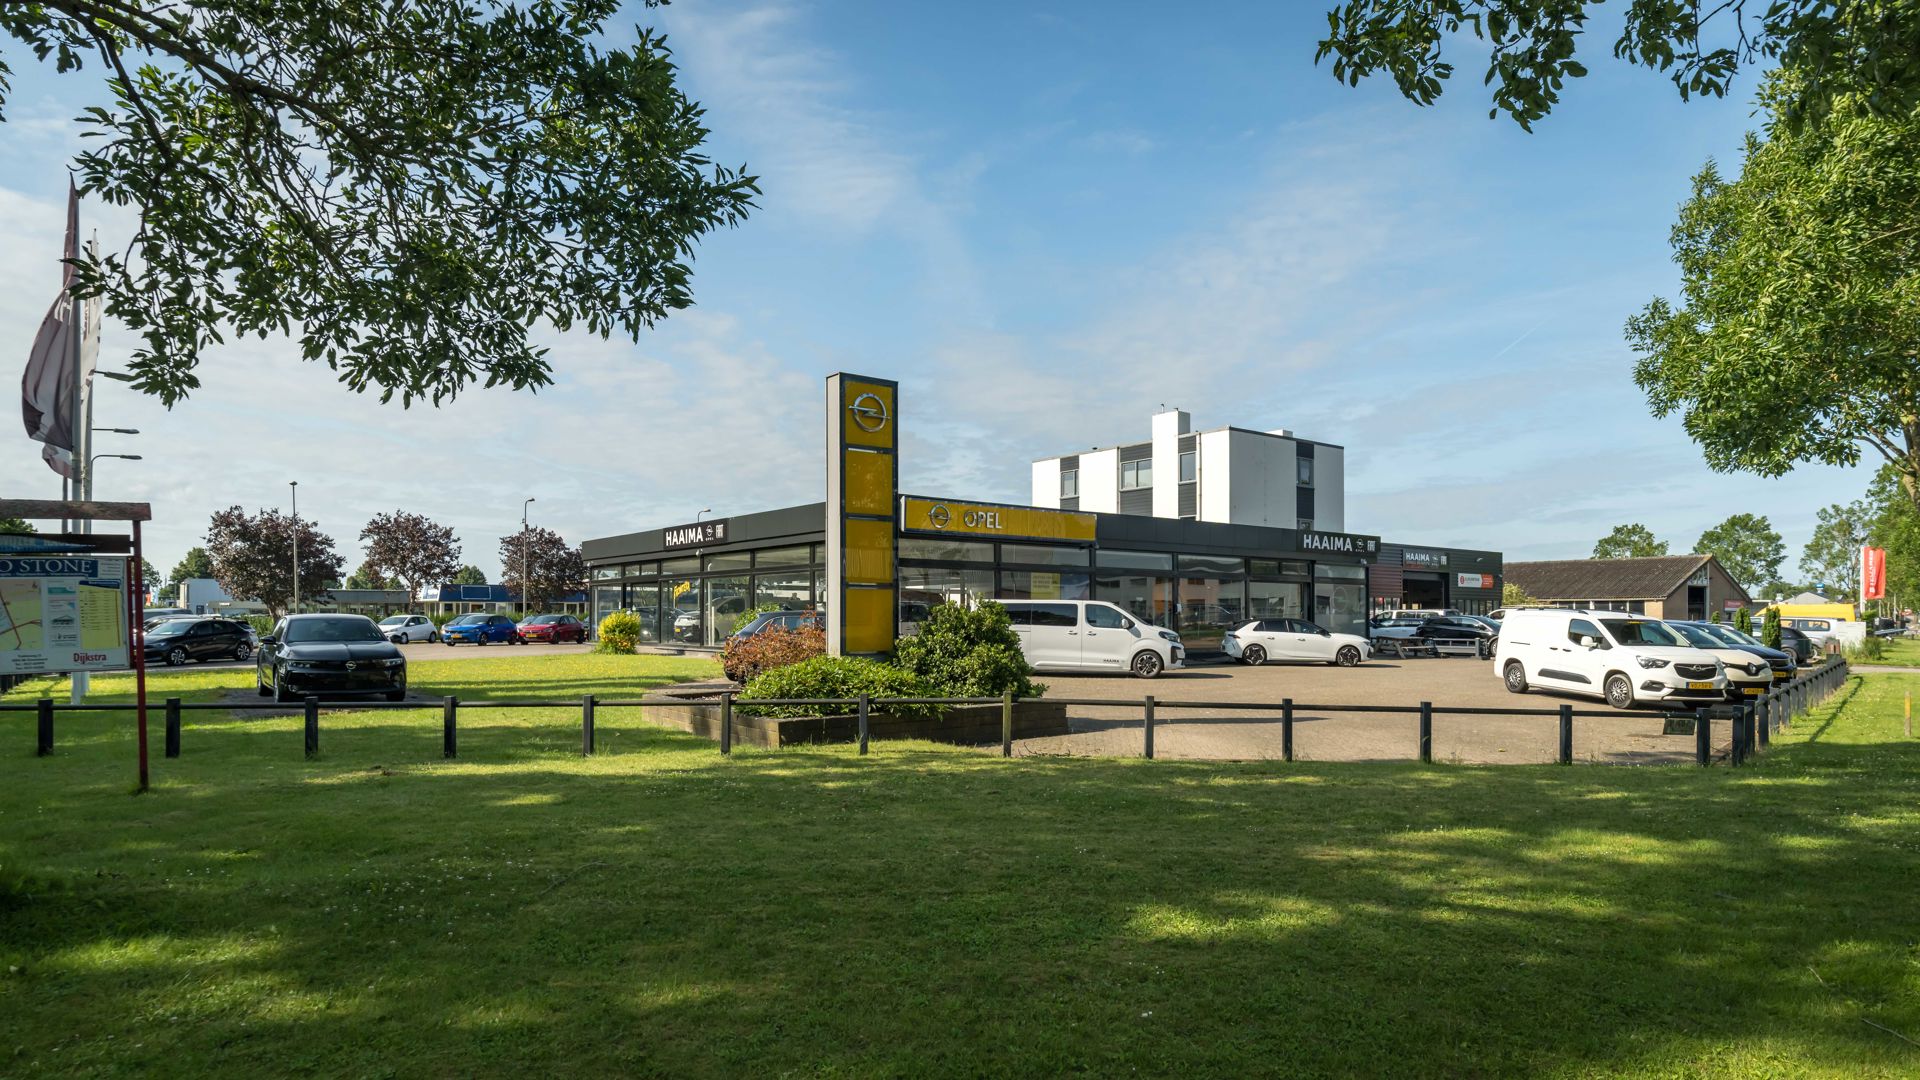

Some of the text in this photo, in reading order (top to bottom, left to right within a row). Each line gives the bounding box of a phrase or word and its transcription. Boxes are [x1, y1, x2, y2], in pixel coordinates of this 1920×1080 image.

[964, 511, 1002, 528] OPEL
[665, 526, 703, 546] HAAIMA
[1303, 534, 1353, 551] HAAIMA
[20, 559, 93, 573] STONE
[73, 653, 107, 664] Dijkstra
